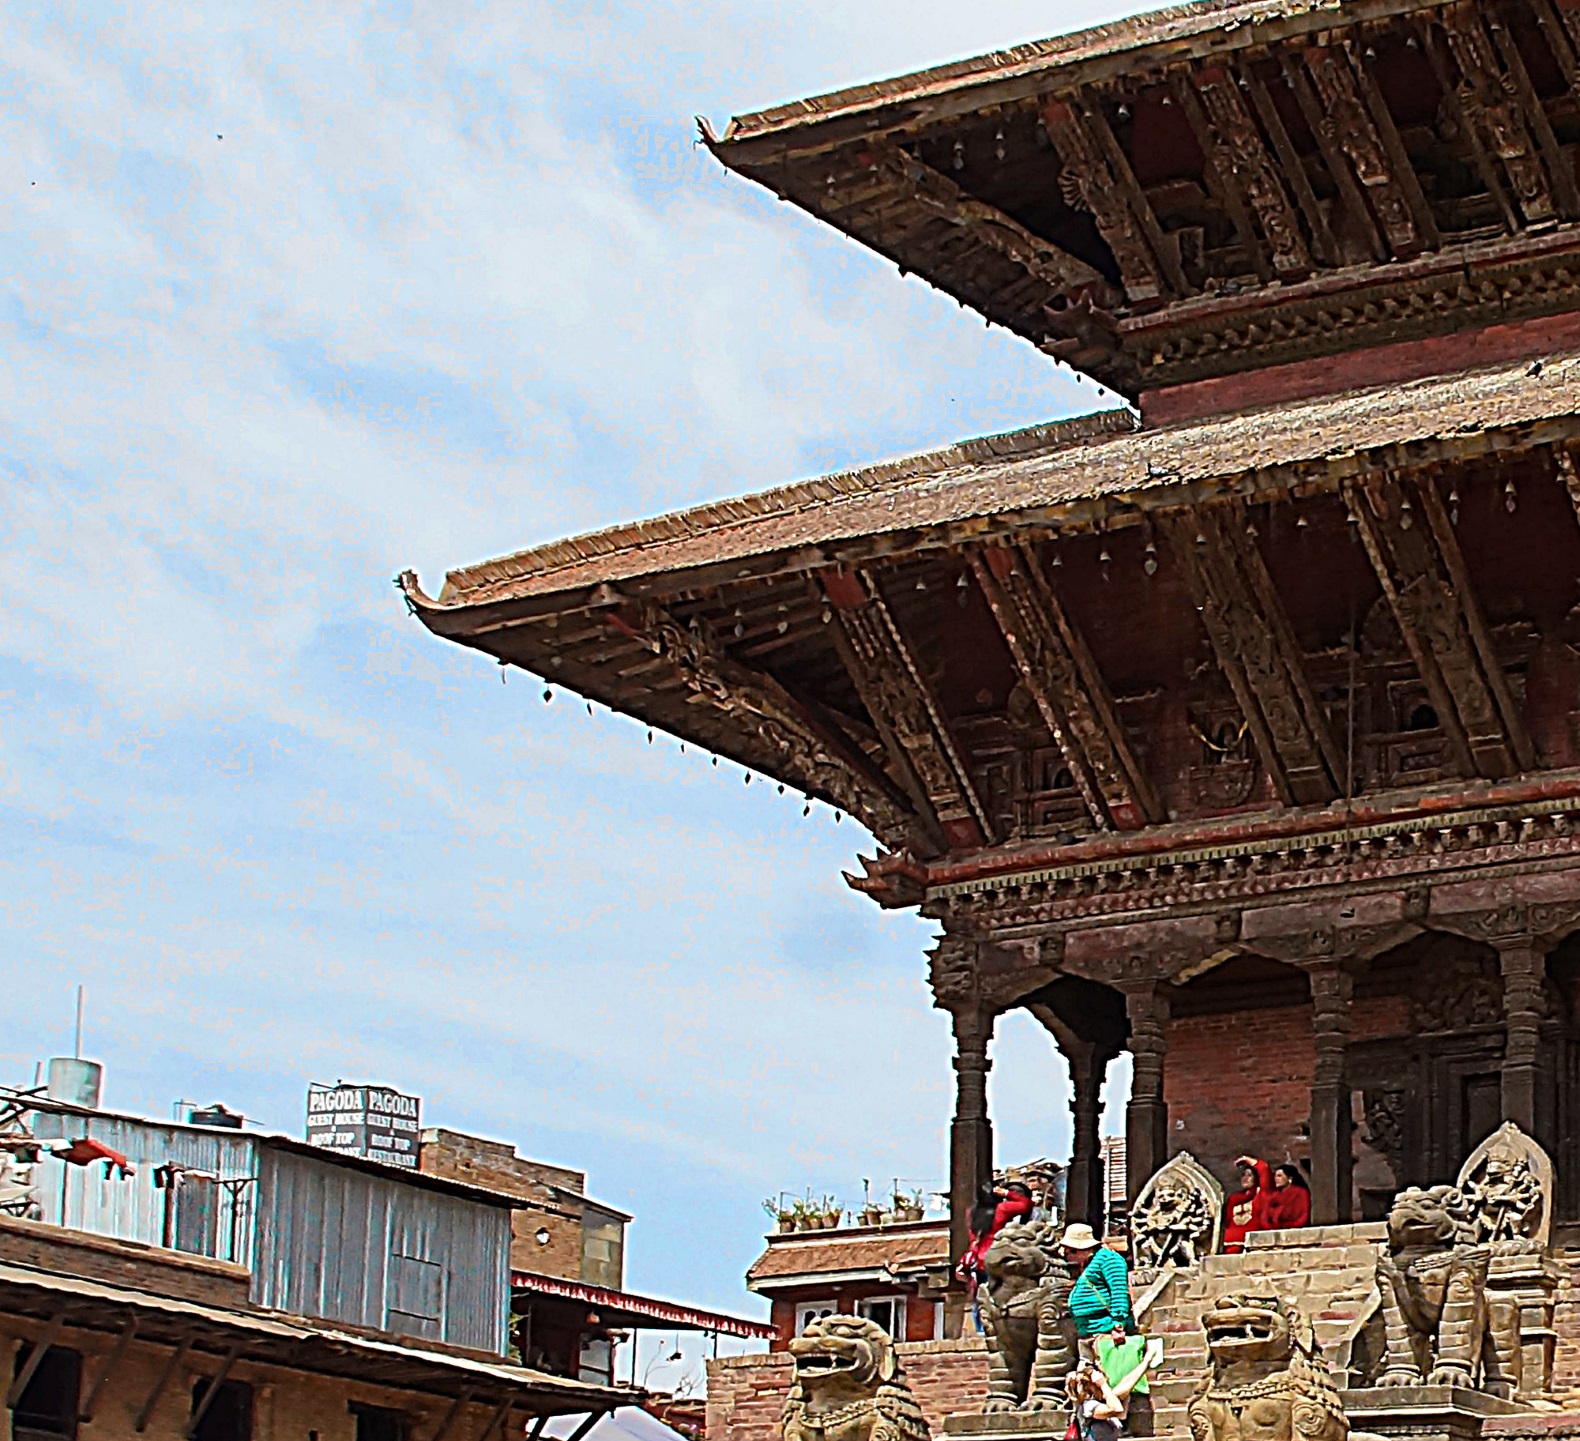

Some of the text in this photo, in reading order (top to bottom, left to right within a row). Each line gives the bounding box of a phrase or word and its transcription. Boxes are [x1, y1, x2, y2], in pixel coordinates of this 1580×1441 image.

[309, 1090, 363, 1112] PAGODA
[368, 1091, 417, 1117] PAGODA
[335, 1132, 355, 1145] TOP
